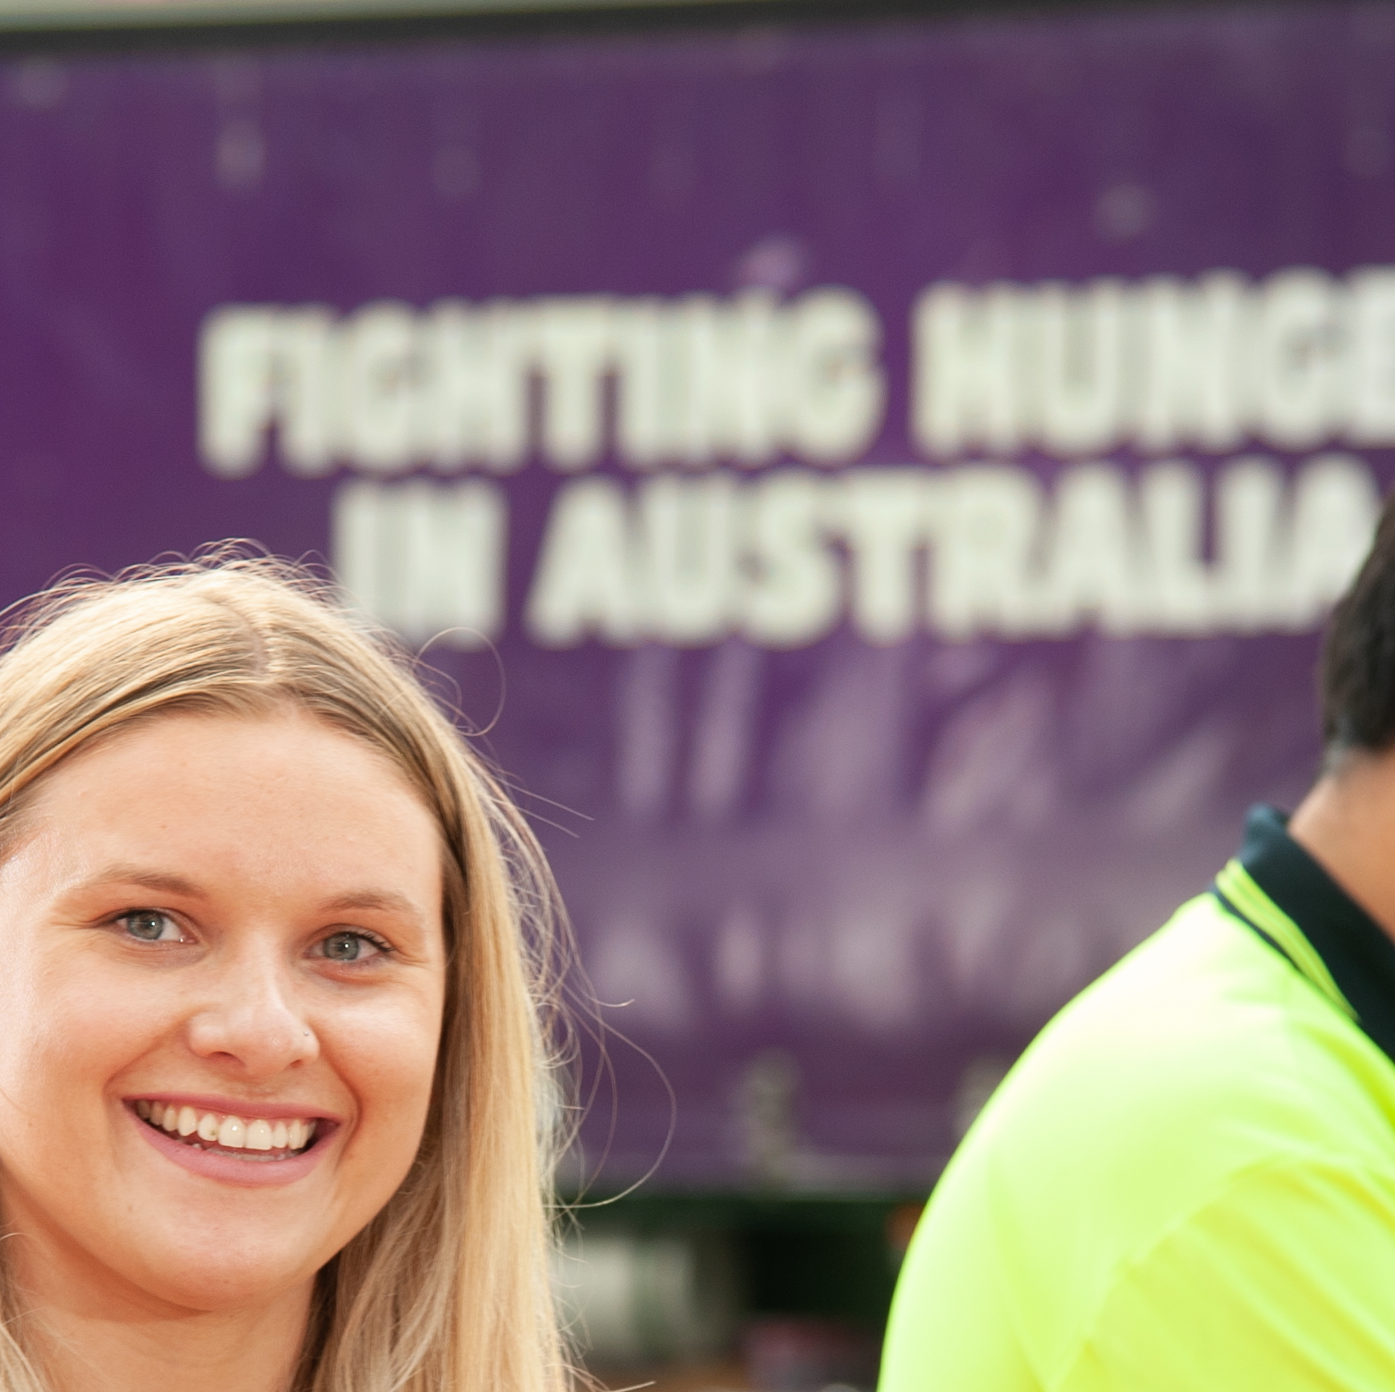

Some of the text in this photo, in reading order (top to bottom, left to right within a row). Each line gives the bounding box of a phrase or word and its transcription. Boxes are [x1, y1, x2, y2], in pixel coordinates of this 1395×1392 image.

[201, 290, 881, 474] FIGHTING
[333, 483, 505, 647] IN
[529, 460, 1382, 645] AUSTRALIA
